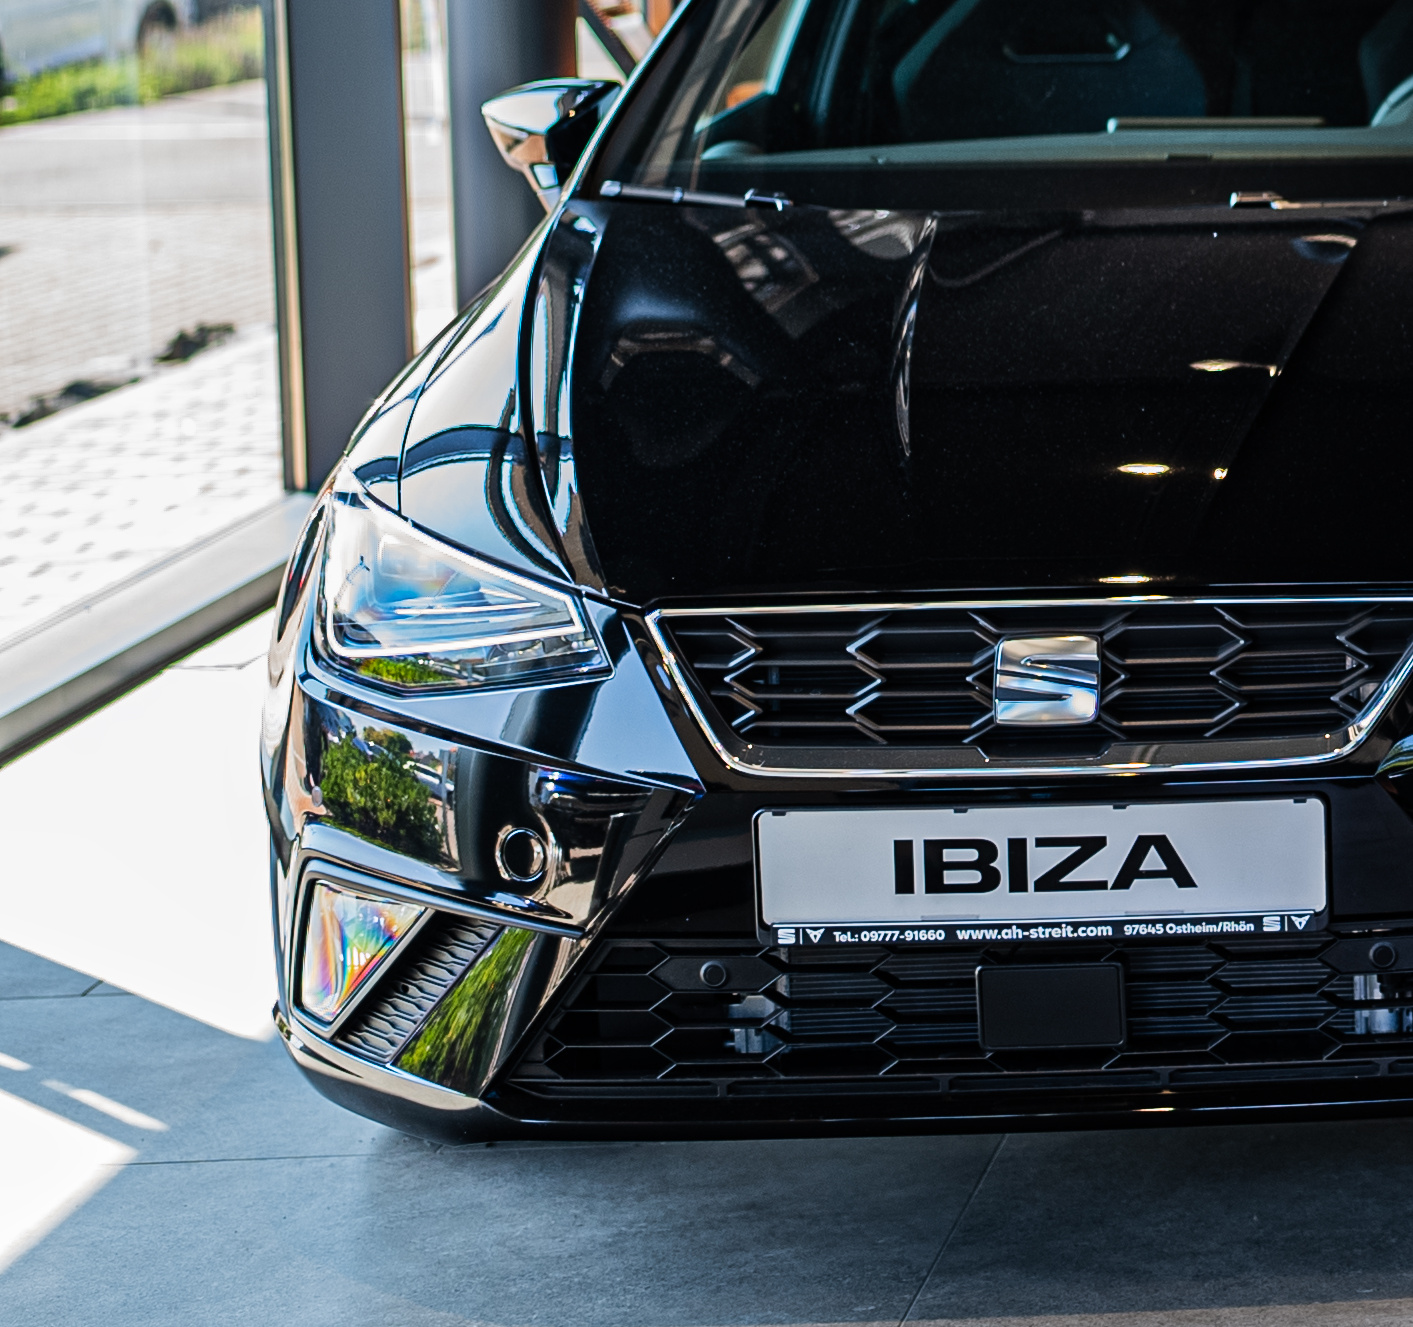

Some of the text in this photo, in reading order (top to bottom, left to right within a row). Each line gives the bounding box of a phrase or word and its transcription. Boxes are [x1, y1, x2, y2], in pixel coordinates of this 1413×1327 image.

[894, 834, 1198, 895] IBIZA
[860, 929, 946, 942] 09777-91660
[956, 924, 1113, 940] www.ah-streit.com
[1123, 923, 1164, 935] 97645
[1165, 920, 1255, 935] Ostheim/Rhön
